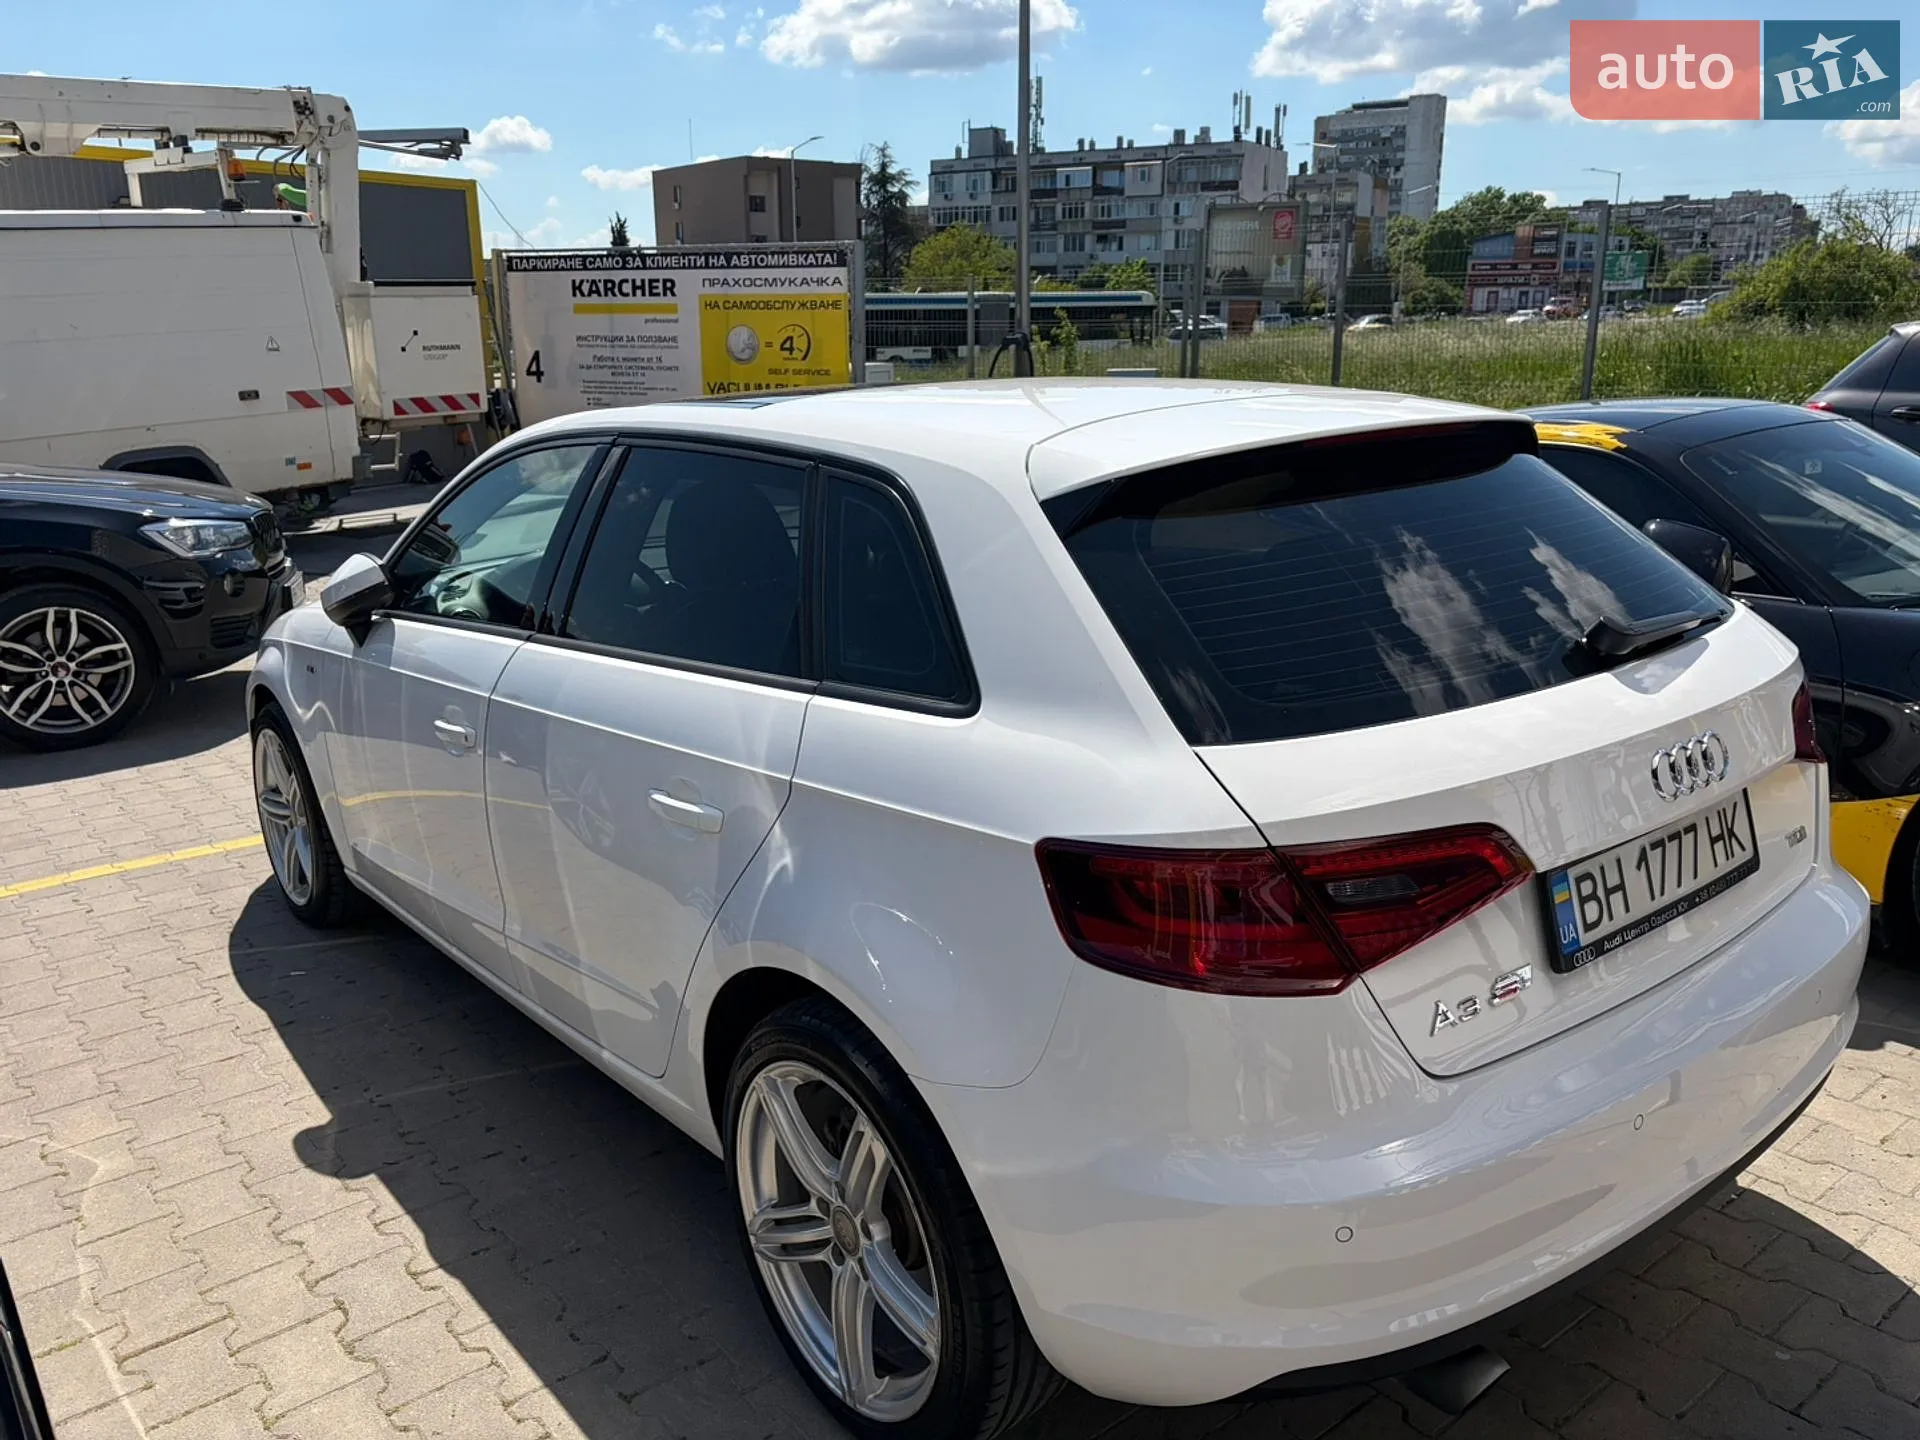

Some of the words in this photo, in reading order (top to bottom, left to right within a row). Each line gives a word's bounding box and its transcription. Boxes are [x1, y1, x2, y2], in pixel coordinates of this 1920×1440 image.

[513, 257, 583, 270] ПАРКИРАНЕ
[585, 256, 623, 269] САМО
[625, 256, 642, 268] ЗА
[645, 256, 705, 268] КЛИЕНТИ
[708, 255, 727, 267] НА
[730, 253, 838, 267] АВТОМИВКАТА!
[571, 278, 677, 298] KÄRCHER
[702, 276, 843, 288] ПРАХОСМУКАЧКА
[704, 300, 719, 310] НА
[722, 300, 842, 310] САМООБСЛУЖВАНЕ
[576, 335, 624, 343] ИНСТРУКЦИИ
[626, 335, 636, 343] ЗА
[779, 336, 795, 355] 4
[525, 350, 545, 384] 4
[768, 368, 790, 376] SELF
[791, 368, 831, 376] SERVICE
[1574, 855, 1631, 933] BH
[1635, 822, 1698, 902] 1777
[1705, 801, 1747, 868] HK
[1559, 923, 1577, 944] UA
[1603, 932, 1624, 951] Audi
[1622, 921, 1650, 941] Центр
[1650, 908, 1678, 927] Одесса
[1429, 994, 1481, 1038] A3
